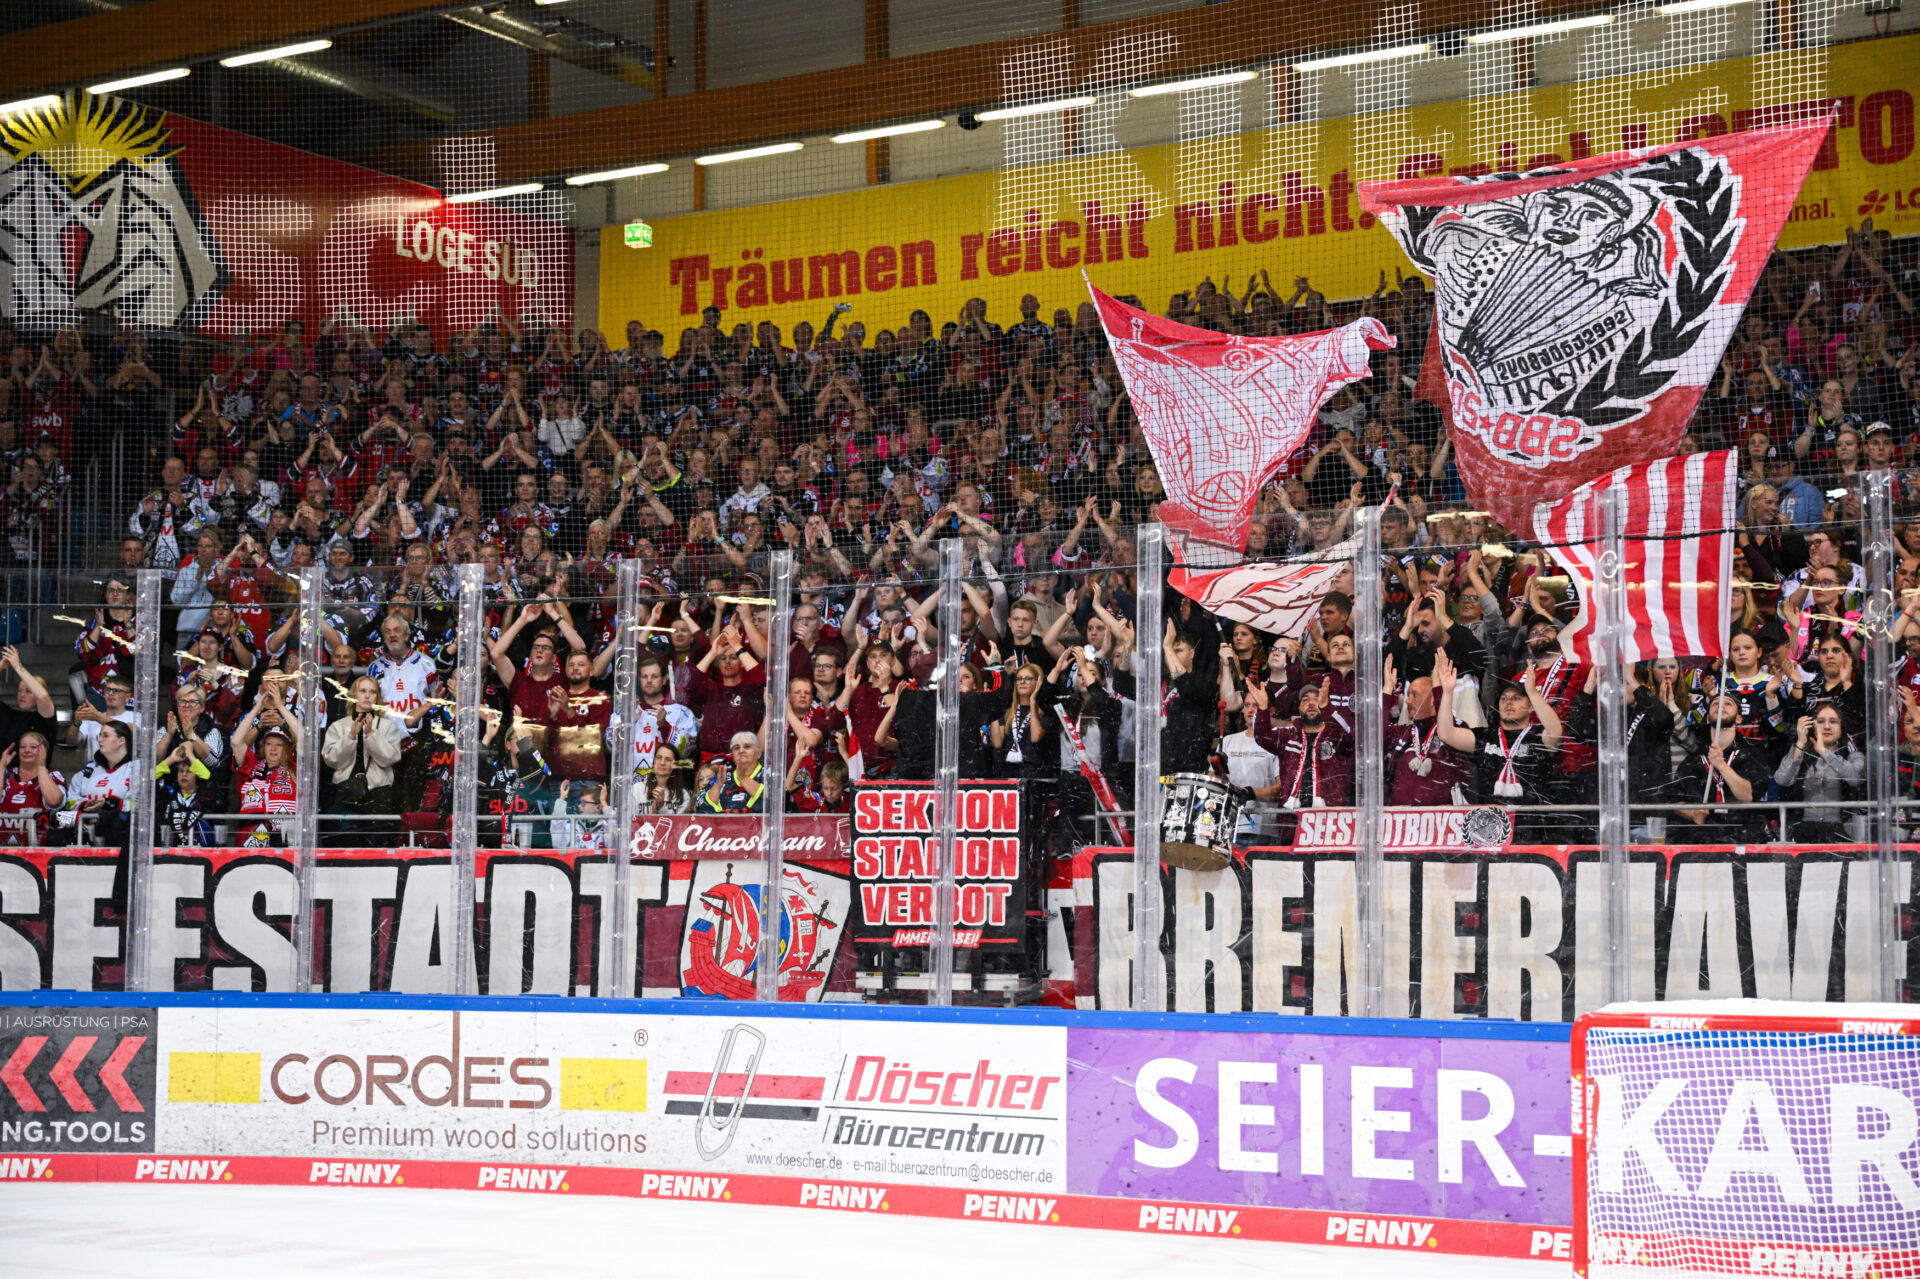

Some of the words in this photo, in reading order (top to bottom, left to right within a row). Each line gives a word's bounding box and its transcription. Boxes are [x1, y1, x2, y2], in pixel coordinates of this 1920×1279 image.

[396, 215, 475, 273] LOGE
[484, 235, 541, 289] SÜD
[670, 239, 937, 316] Träumen
[960, 198, 1149, 280] reicht
[1174, 169, 1376, 253] nicht.
[13, 1015, 110, 1028] AUSRÜSTUNG
[121, 1016, 148, 1028] PSA
[845, 1055, 1061, 1110] Döscher
[312, 1120, 434, 1147] Premium
[445, 1123, 516, 1150] wood
[527, 1125, 647, 1153] solutions
[833, 1115, 1045, 1156] Bürozentrum
[746, 1152, 843, 1170] www.doescher.de
